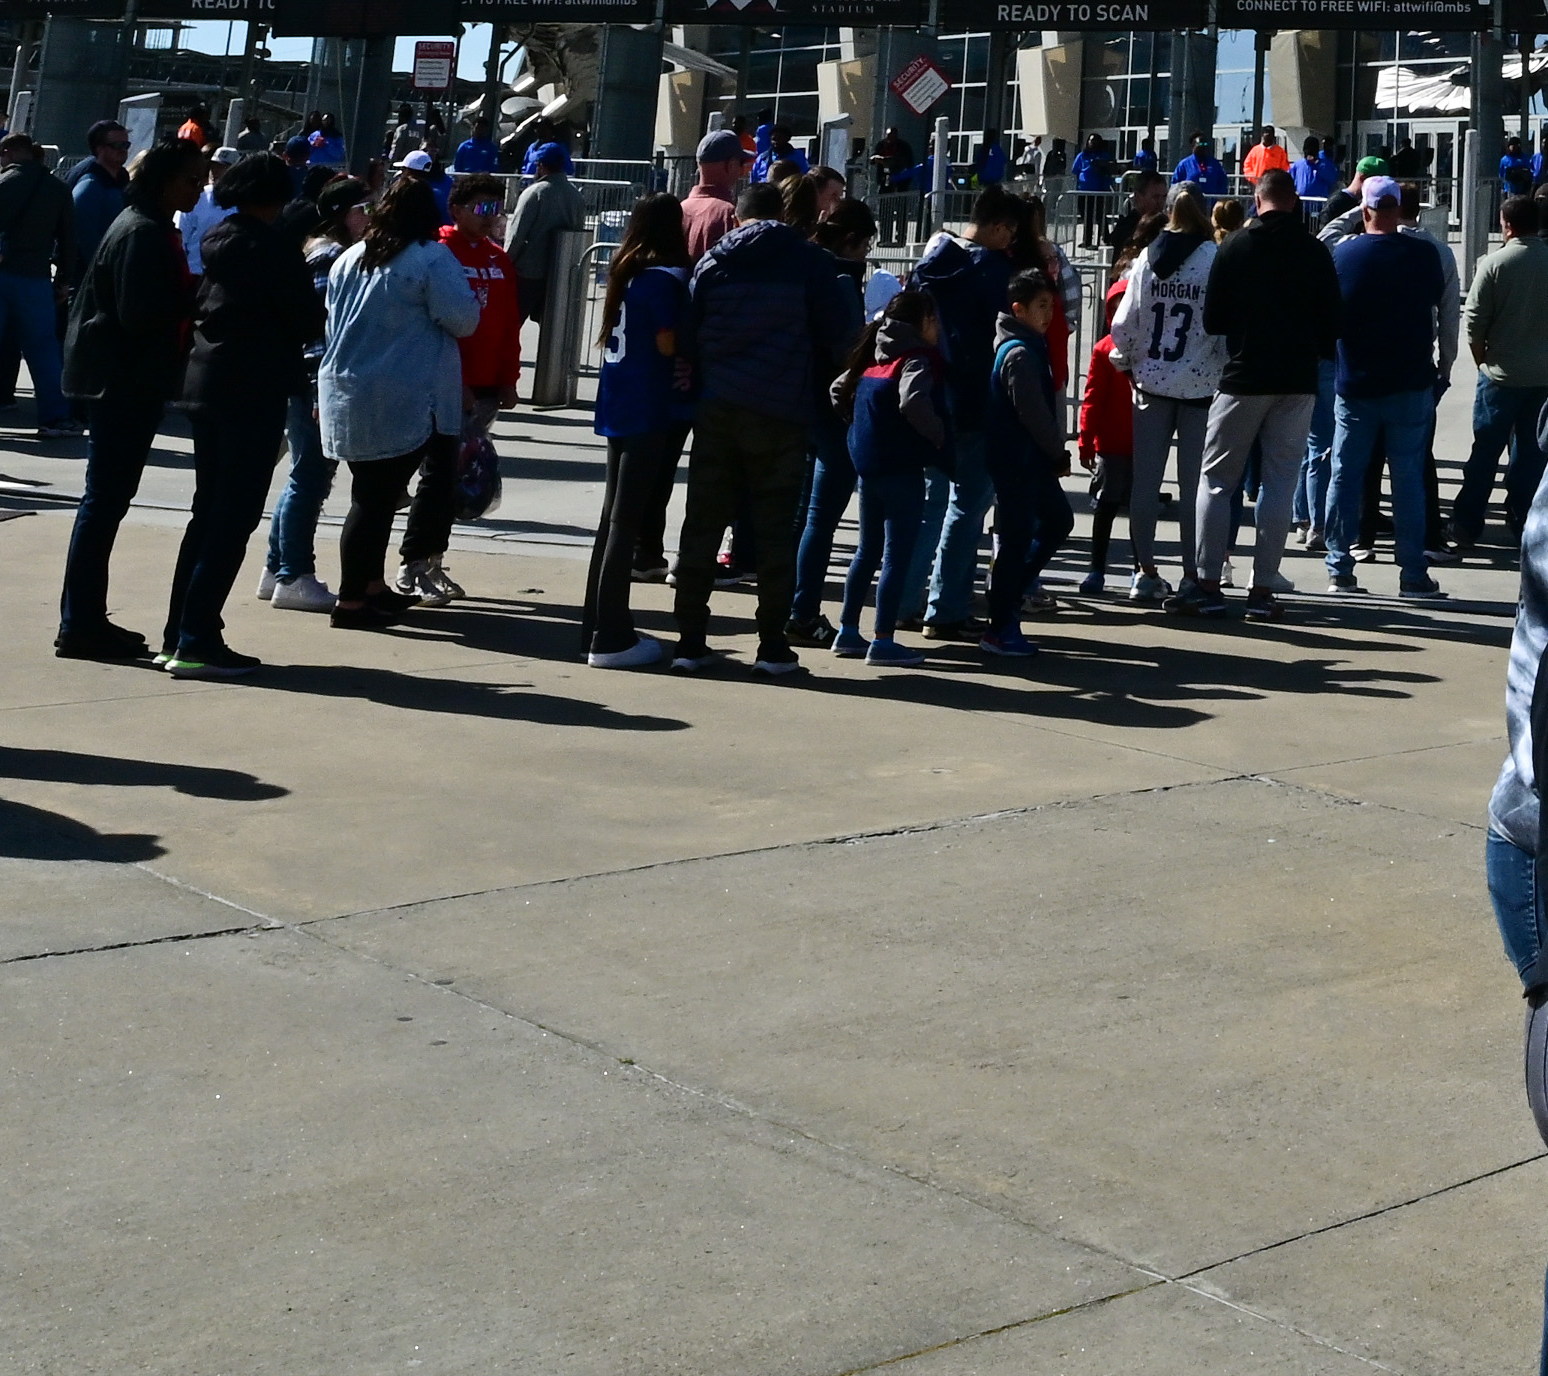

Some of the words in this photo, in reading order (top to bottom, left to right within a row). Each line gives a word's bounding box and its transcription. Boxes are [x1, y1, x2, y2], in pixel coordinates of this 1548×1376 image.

[811, 5, 874, 14] STADIUM
[997, 4, 1062, 22] READY
[1066, 4, 1092, 22] TO
[1096, 4, 1149, 22] SCAN
[1236, 0, 1297, 12] CONNECT
[1301, 0, 1317, 12] TO
[1320, 0, 1354, 12] FREE
[1357, 0, 1390, 13] WIFI:
[1394, 0, 1472, 13] attwifi@mbs
[893, 58, 924, 88] SECURITY
[1151, 280, 1200, 300] MORGAN
[1147, 302, 1194, 362] 13
